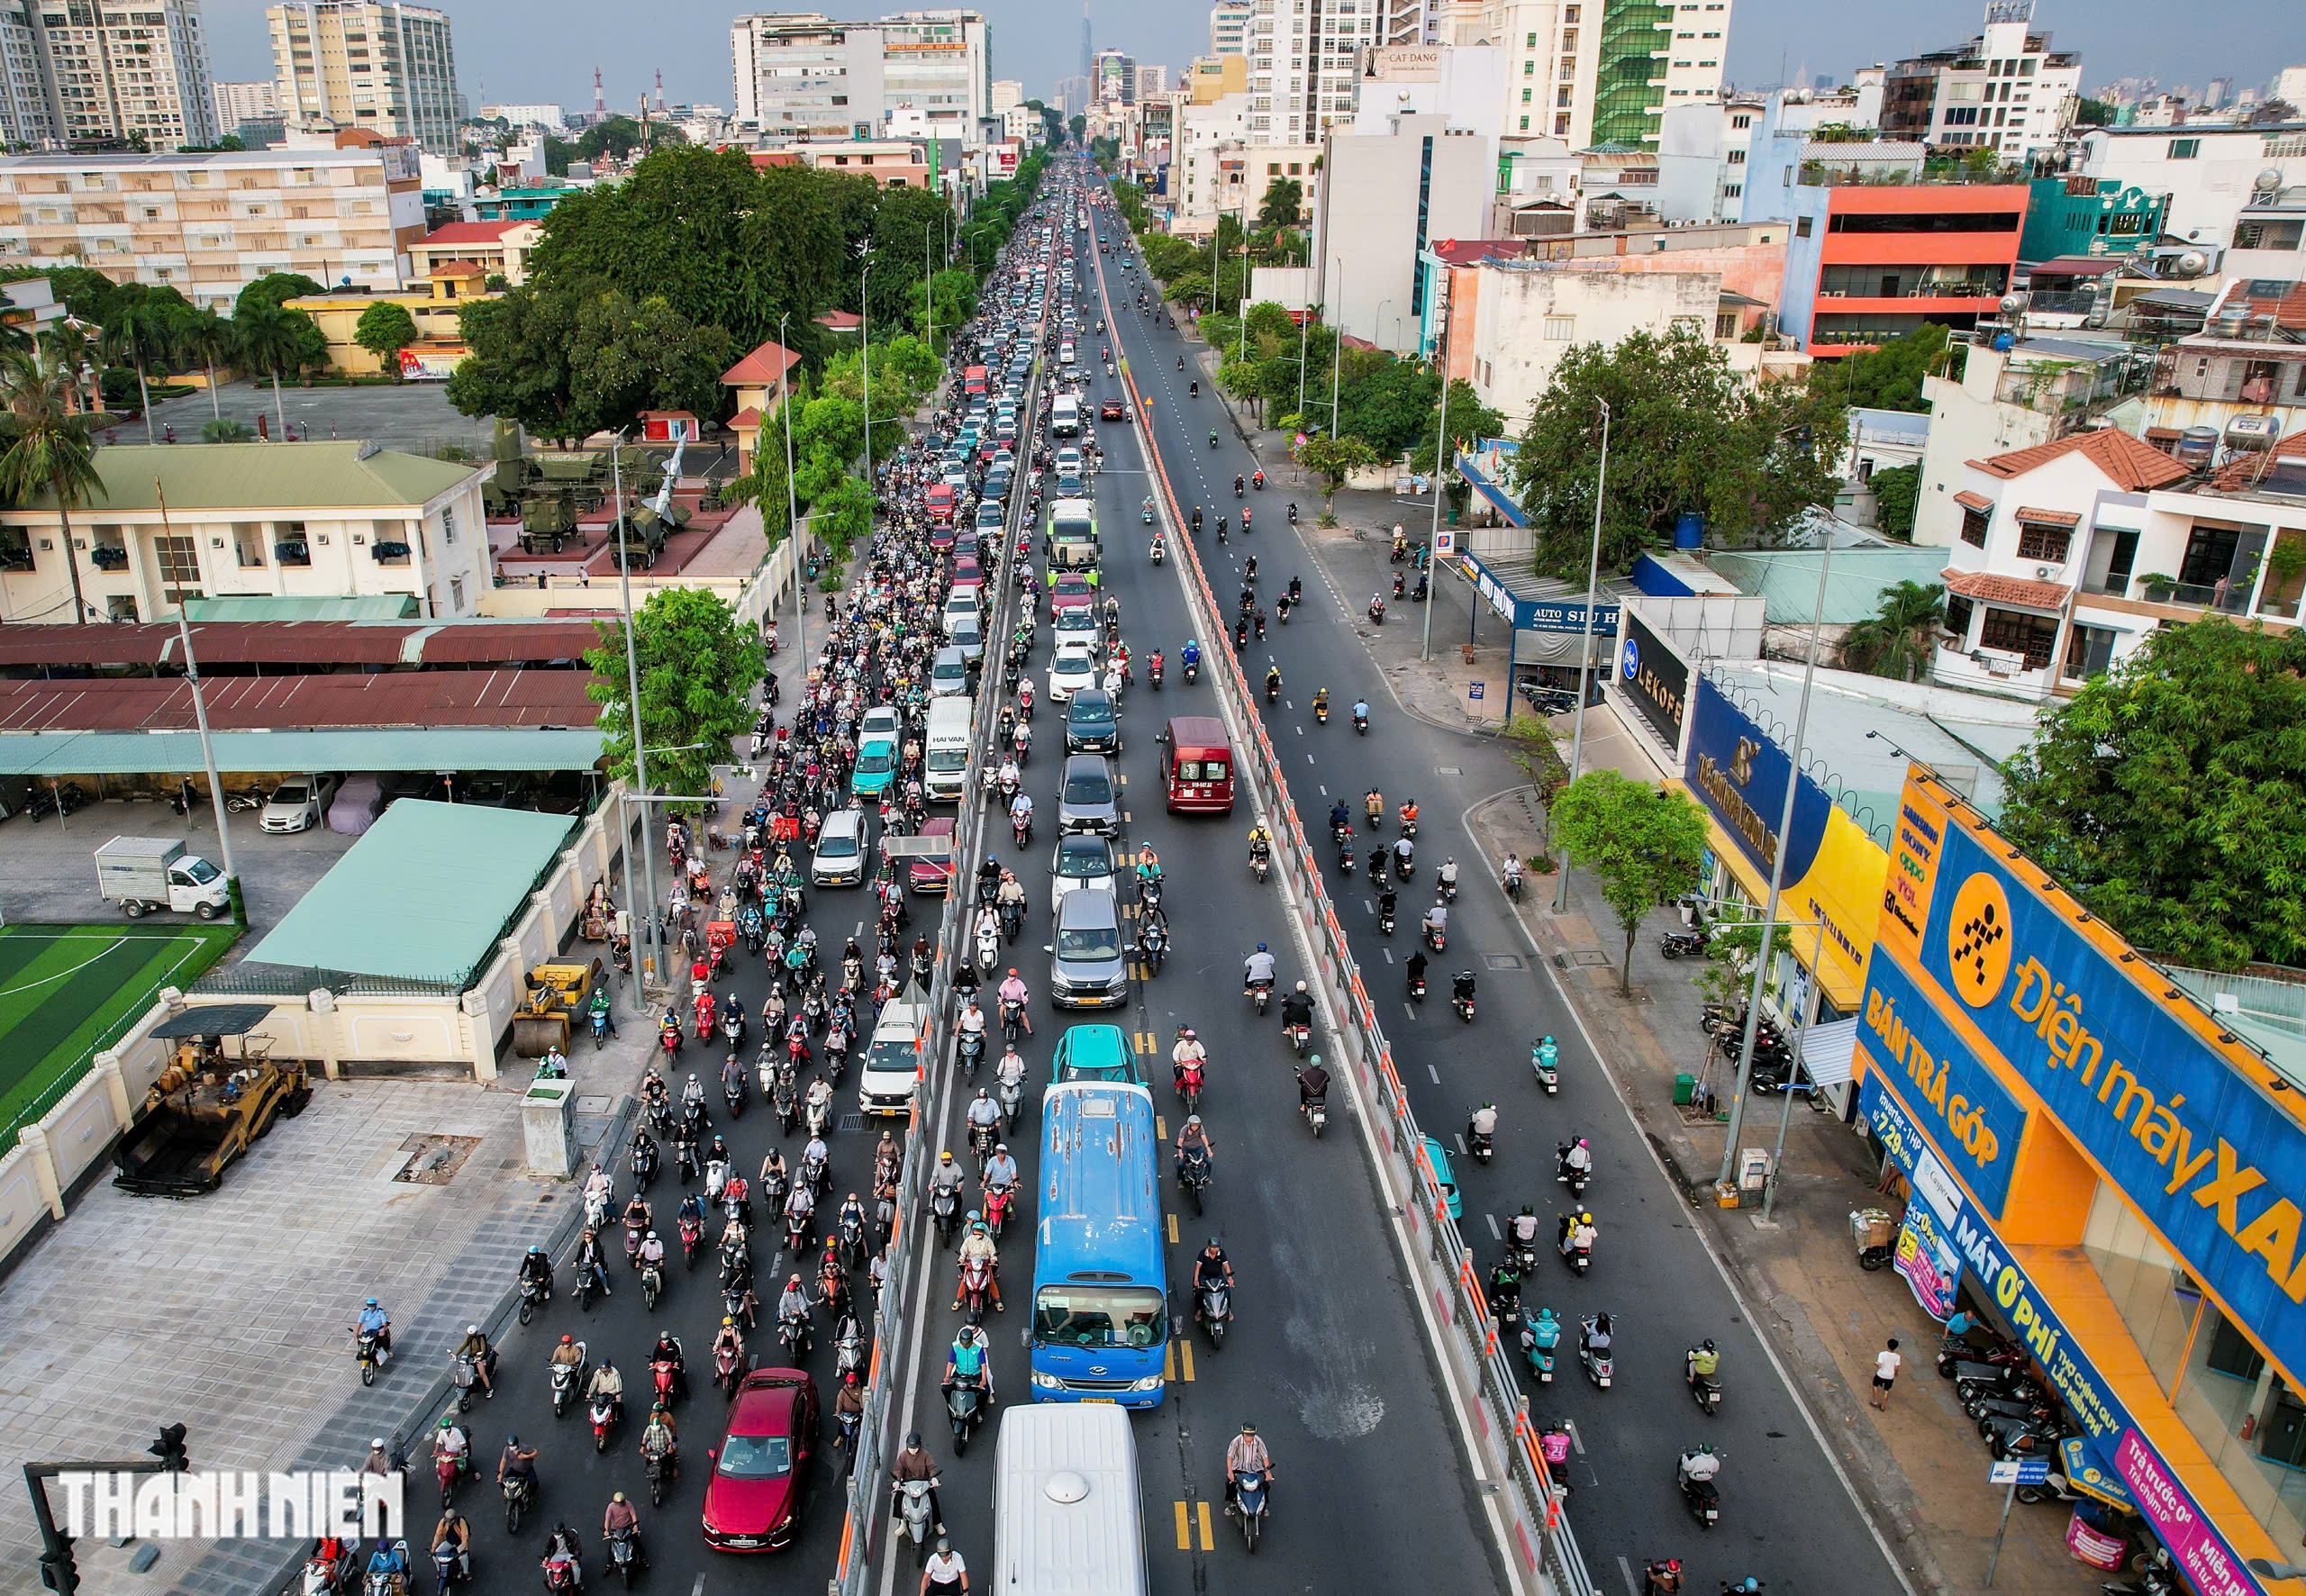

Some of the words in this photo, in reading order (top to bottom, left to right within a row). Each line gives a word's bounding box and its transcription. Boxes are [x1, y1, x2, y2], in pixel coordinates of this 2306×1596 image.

[1389, 53, 1406, 62] CAT
[1410, 53, 1437, 62] DANG
[1534, 609, 1562, 618] AUTO
[1638, 661, 1683, 727] LEKOFE
[1902, 804, 1939, 846] SAMSUNG
[1902, 828, 1932, 864] SONY
[1897, 875, 1916, 908] TCL
[1866, 986, 1911, 1065] BÁN
[1906, 1033, 1950, 1118] TRẢ
[1947, 1093, 1999, 1168] GÓP
[2010, 955, 2103, 1086] Điện
[2096, 1059, 2216, 1195] máy
[1876, 1111, 1902, 1156] 7,29
[1929, 1169, 1948, 1197] Casper
[1955, 1214, 2001, 1284] MÁT
[2012, 1294, 2062, 1365] PHÍ
[2051, 1365, 2068, 1389] LẮP
[2066, 1385, 2087, 1422] MIỄN
[2084, 1414, 2103, 1437] PHÍ
[2057, 1348, 2076, 1378] THỢ
[2074, 1372, 2102, 1410] CHÍNH
[2098, 1402, 2120, 1435] QUY
[1551, 1446, 1564, 1456] 21
[2128, 1438, 2147, 1469] Trả
[2145, 1461, 2177, 1510] trước
[2128, 1464, 2141, 1486] Trả
[2139, 1481, 2162, 1514] chậm
[2199, 1538, 2230, 1585] Miễn
